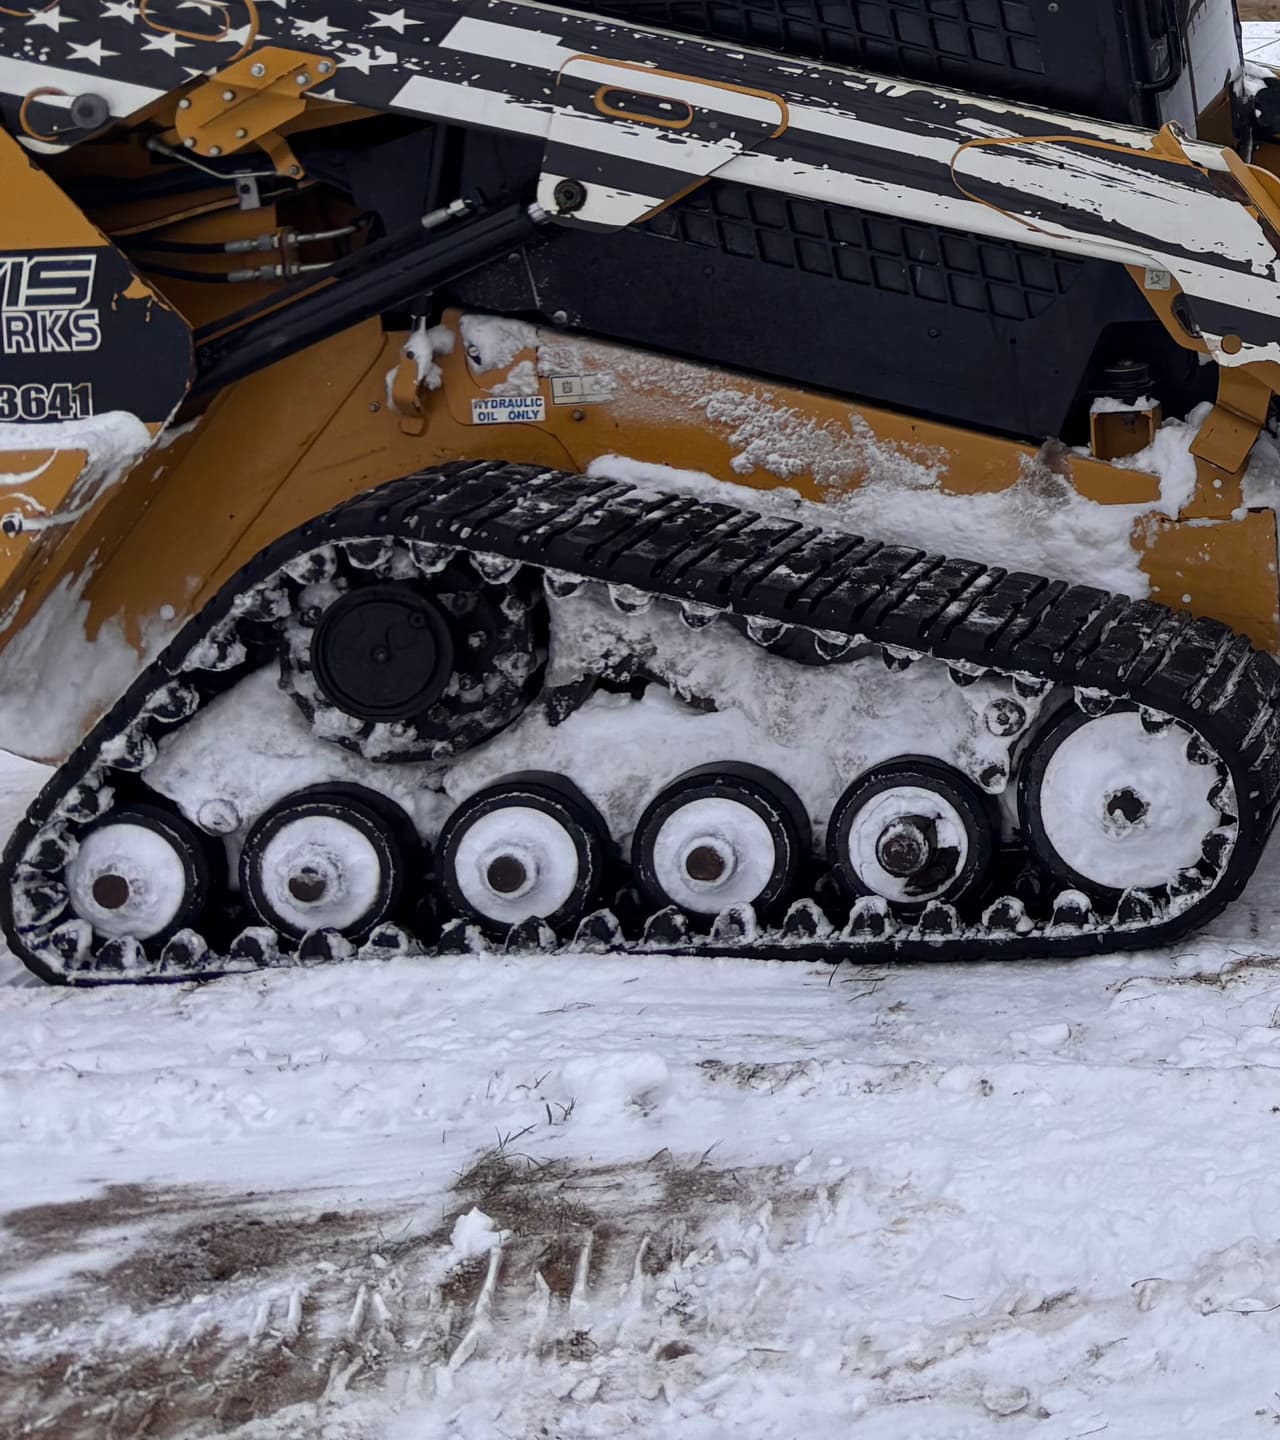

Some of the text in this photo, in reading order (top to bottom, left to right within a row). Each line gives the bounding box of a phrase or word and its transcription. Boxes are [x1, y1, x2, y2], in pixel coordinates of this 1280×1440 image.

[0, 382, 93, 421] 3641
[474, 397, 543, 410] HYDRAULIC
[478, 410, 540, 422] OIL ONLY
